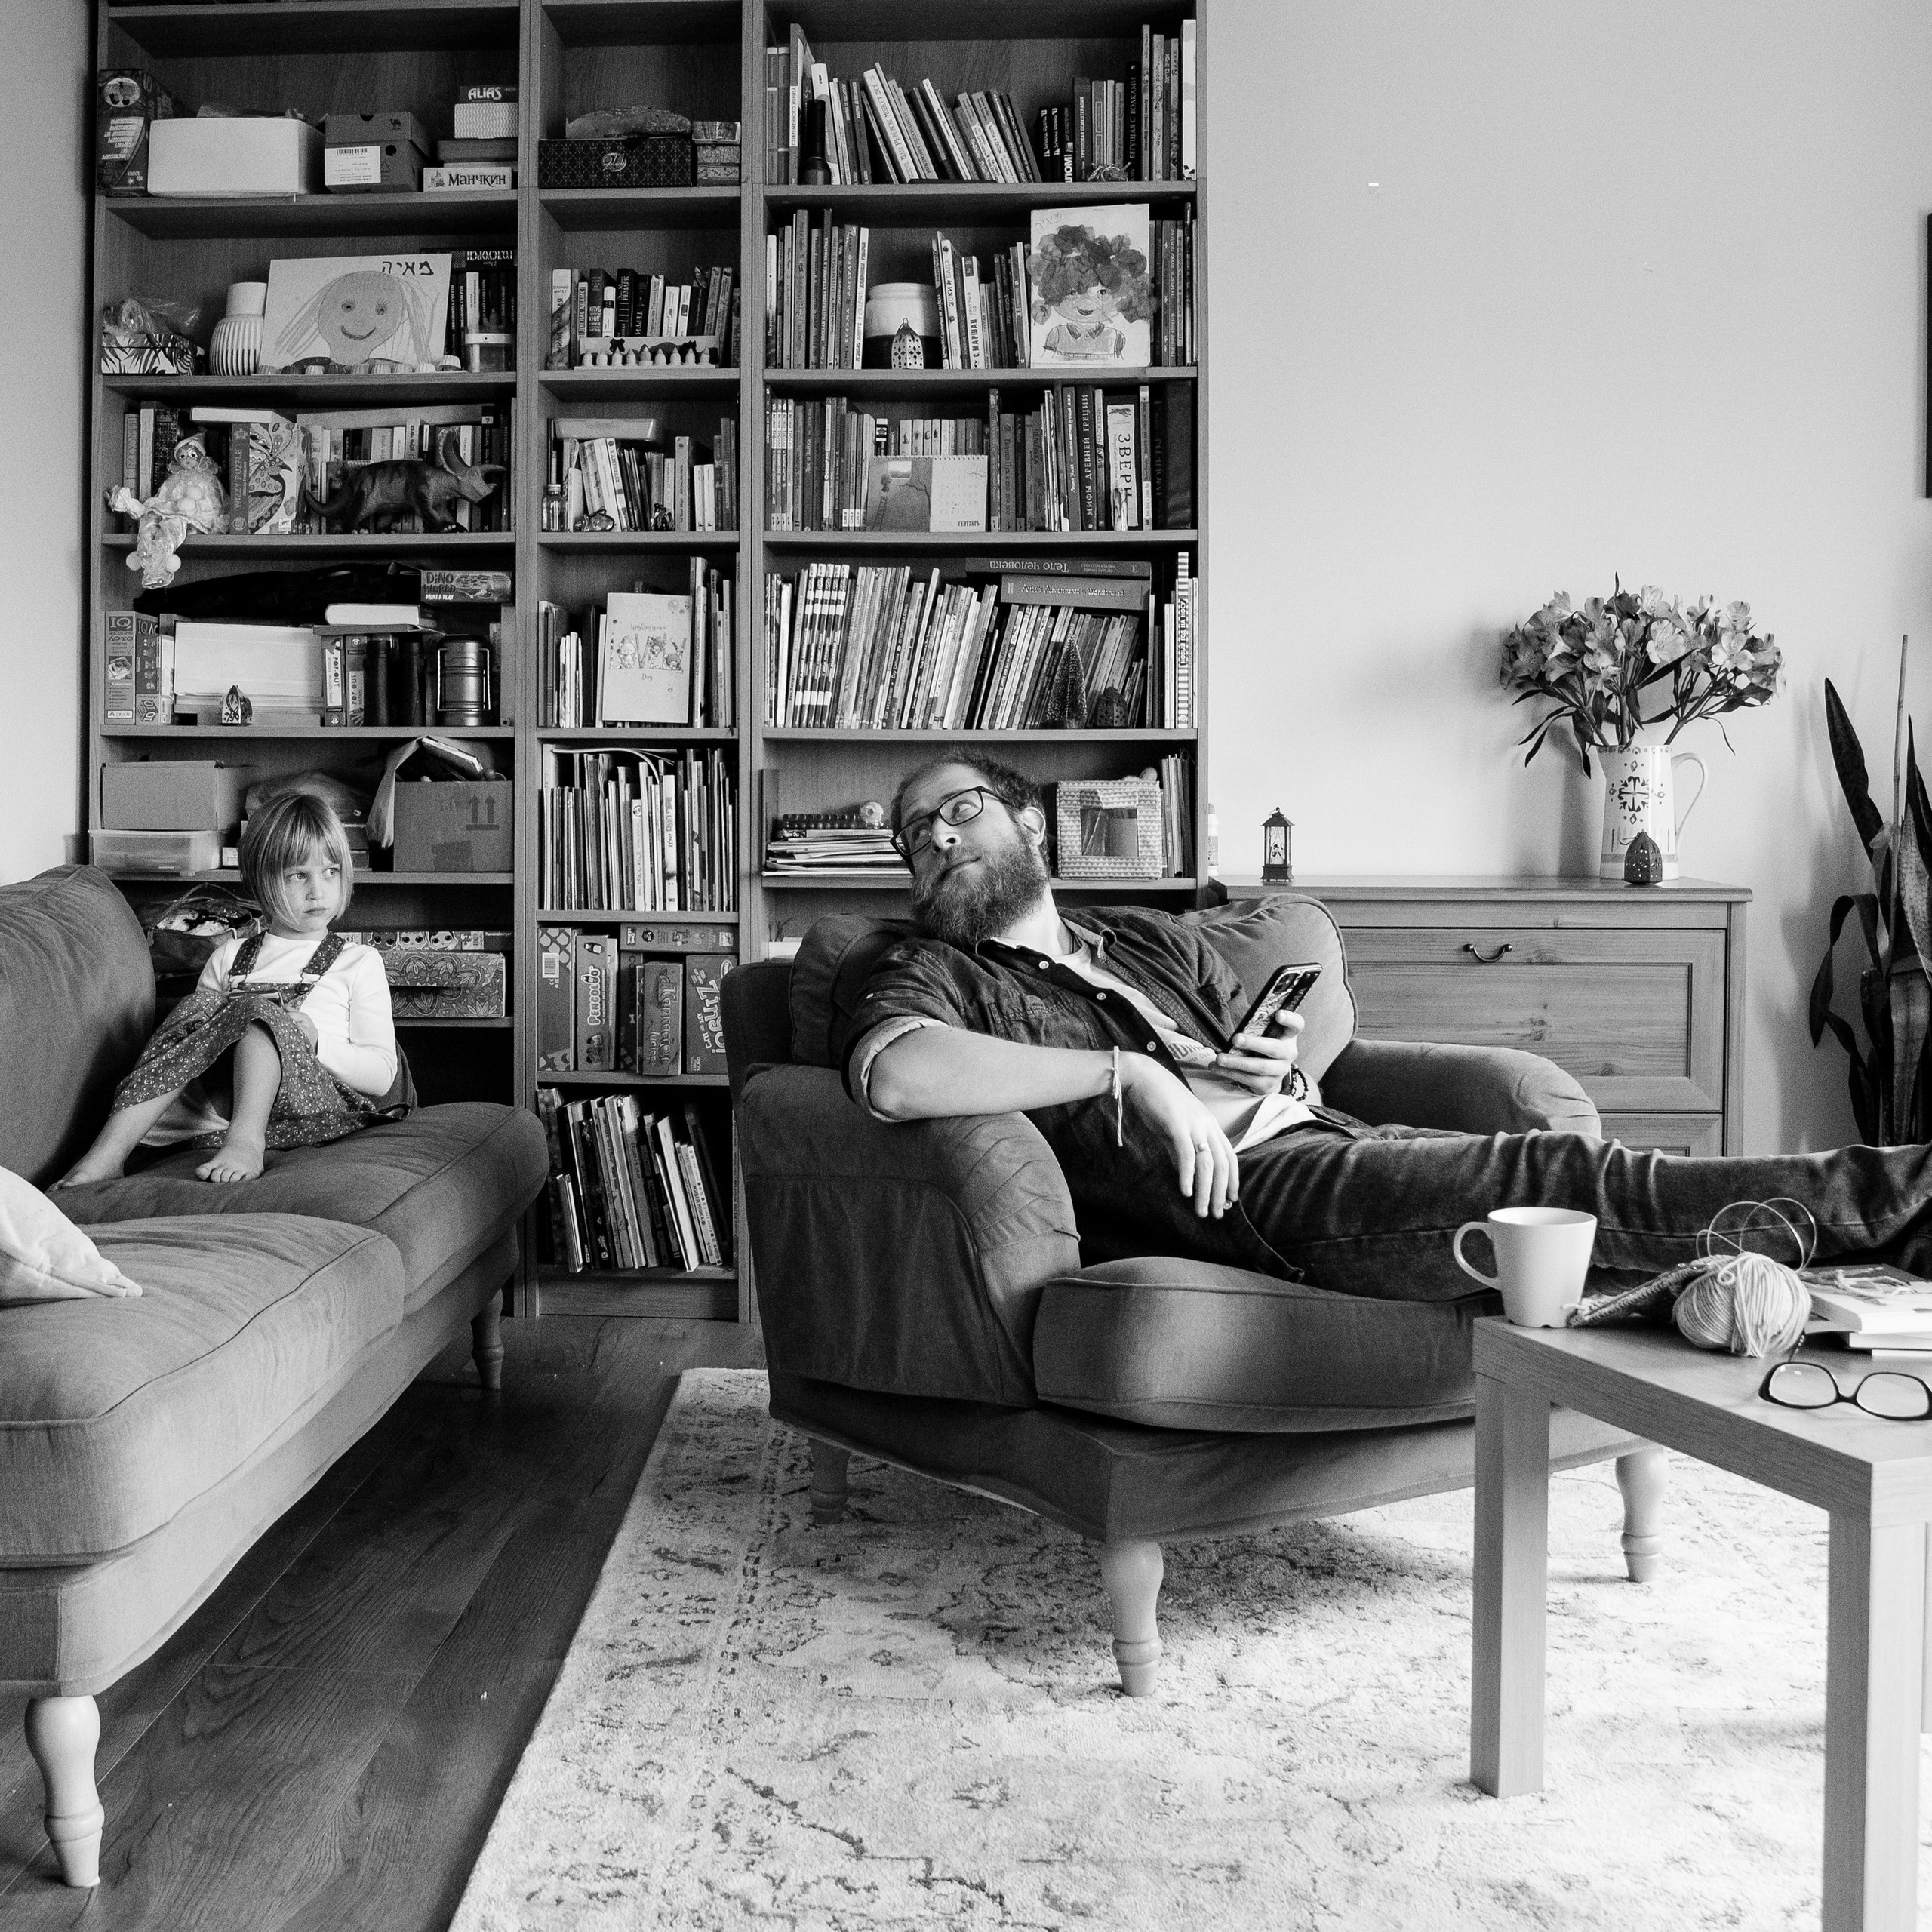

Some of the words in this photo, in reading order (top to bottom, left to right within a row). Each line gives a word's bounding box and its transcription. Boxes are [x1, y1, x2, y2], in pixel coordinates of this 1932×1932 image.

[468, 86, 502, 100] ALIAS
[897, 146, 907, 161] ВАШ
[448, 174, 506, 187] Манчкин
[382, 260, 435, 276] מאיה
[635, 311, 643, 335] ТЕРРИ
[968, 318, 980, 351] МАРШАК
[731, 325, 740, 368] БРЭДБЕРИ
[1081, 393, 1091, 431] ГРЕЦИИ
[1081, 436, 1092, 480] ДРЕВНЕЙ
[1084, 485, 1093, 515] МИФЫ
[989, 560, 1040, 571] человека
[1043, 561, 1069, 573] Тело
[109, 617, 133, 630] IQ
[137, 620, 148, 635] IQ
[1180, 618, 1186, 628] НА
[642, 673, 653, 682] Day
[692, 1186, 701, 1204] ЖИВАЯ
[696, 1203, 704, 1220] КНИГА
